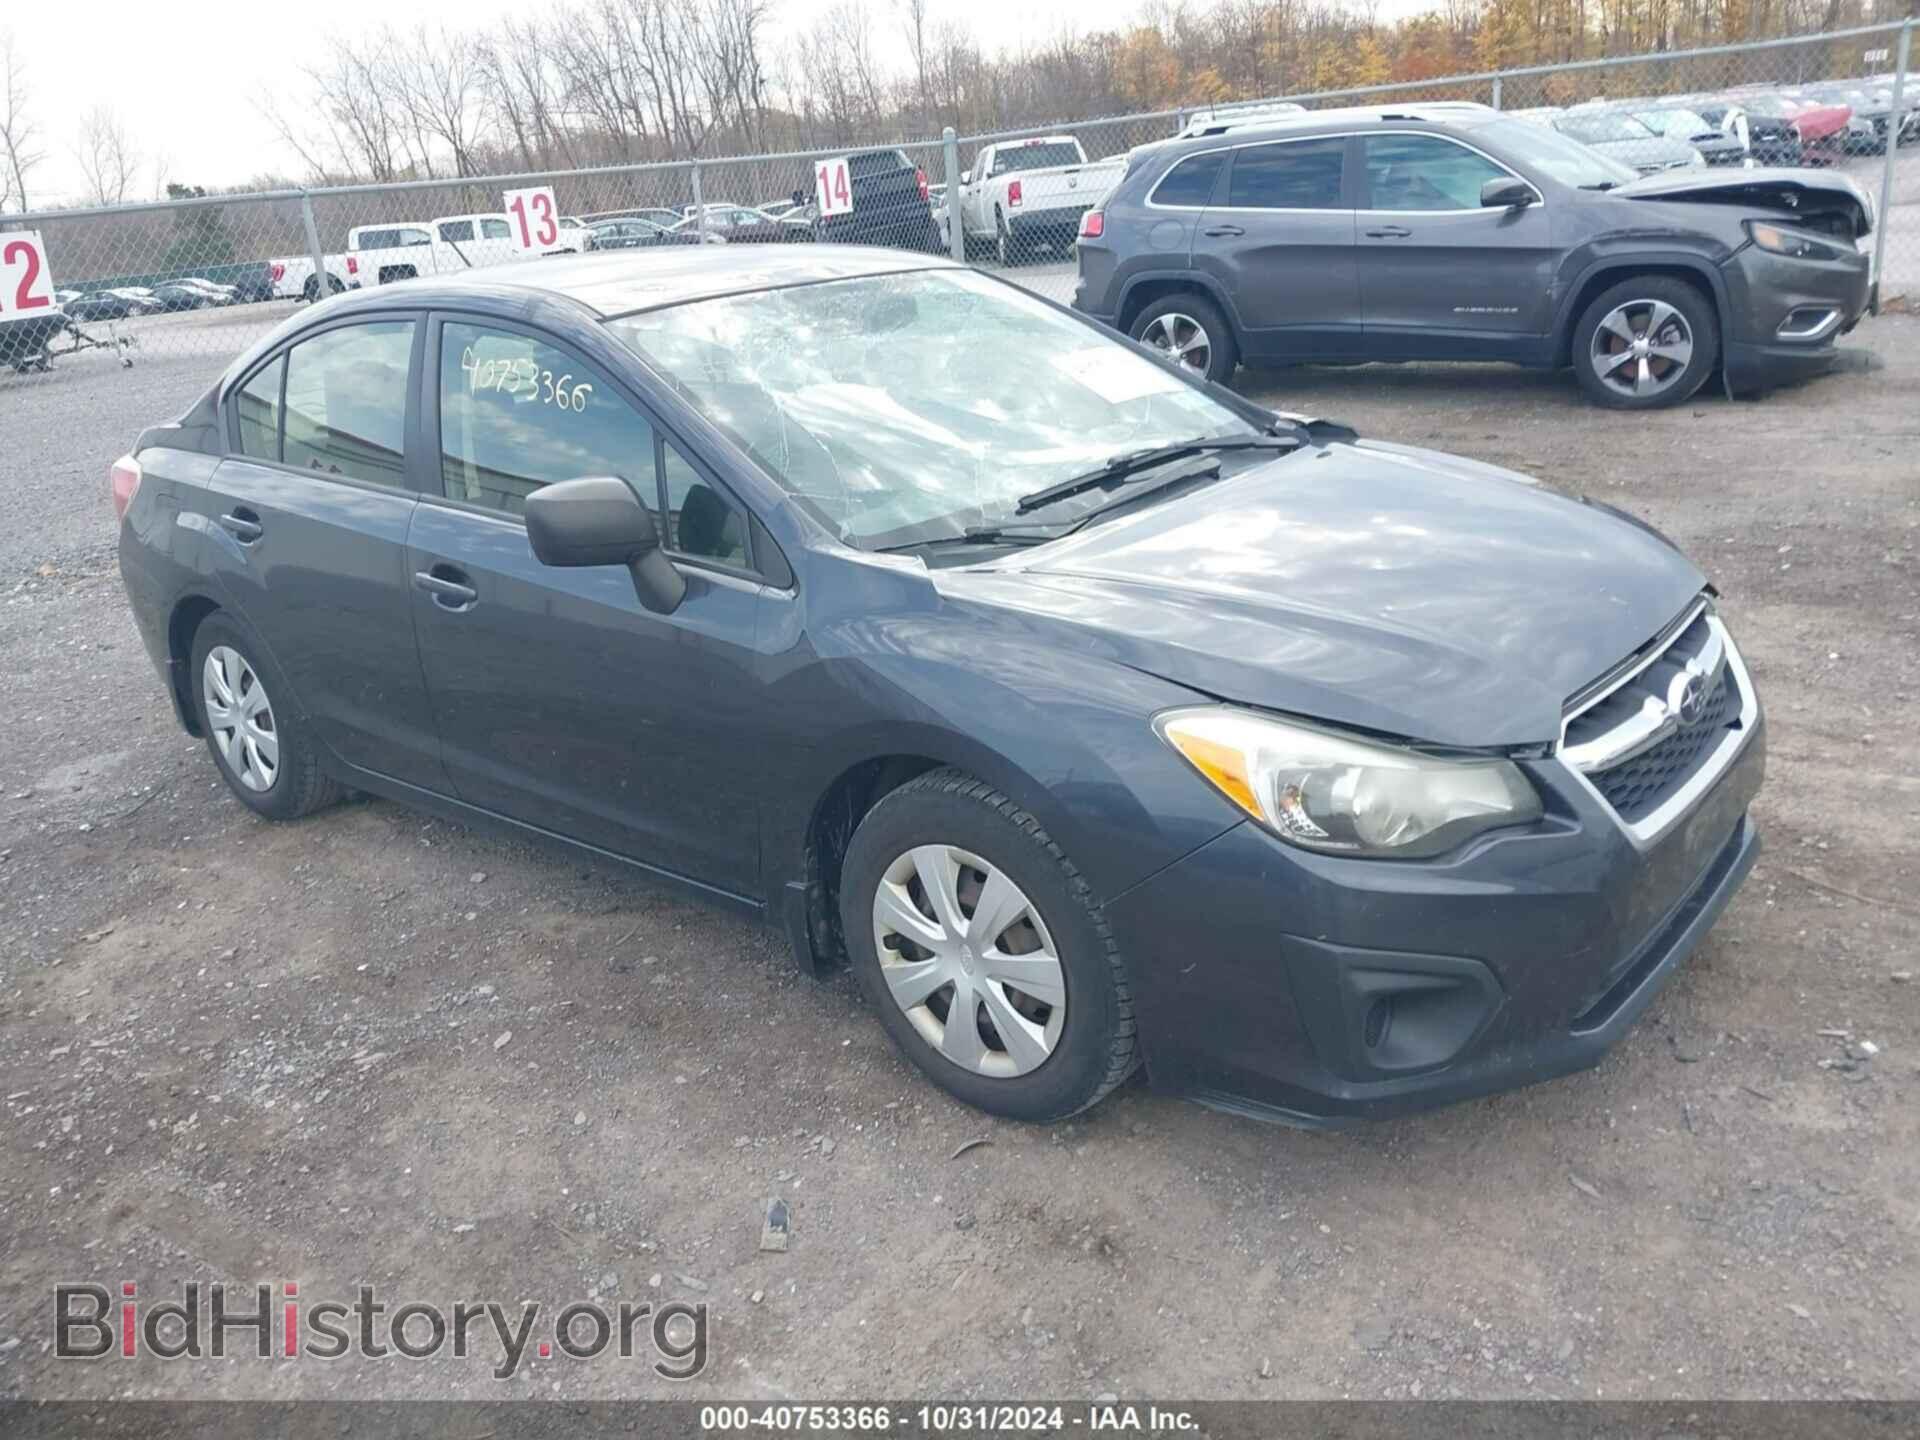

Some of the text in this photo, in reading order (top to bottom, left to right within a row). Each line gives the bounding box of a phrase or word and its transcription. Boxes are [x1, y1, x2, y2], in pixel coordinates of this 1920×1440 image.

[819, 164, 849, 209] 14
[510, 193, 557, 248] 13
[0, 240, 50, 312] 2
[462, 346, 593, 412] 40753366
